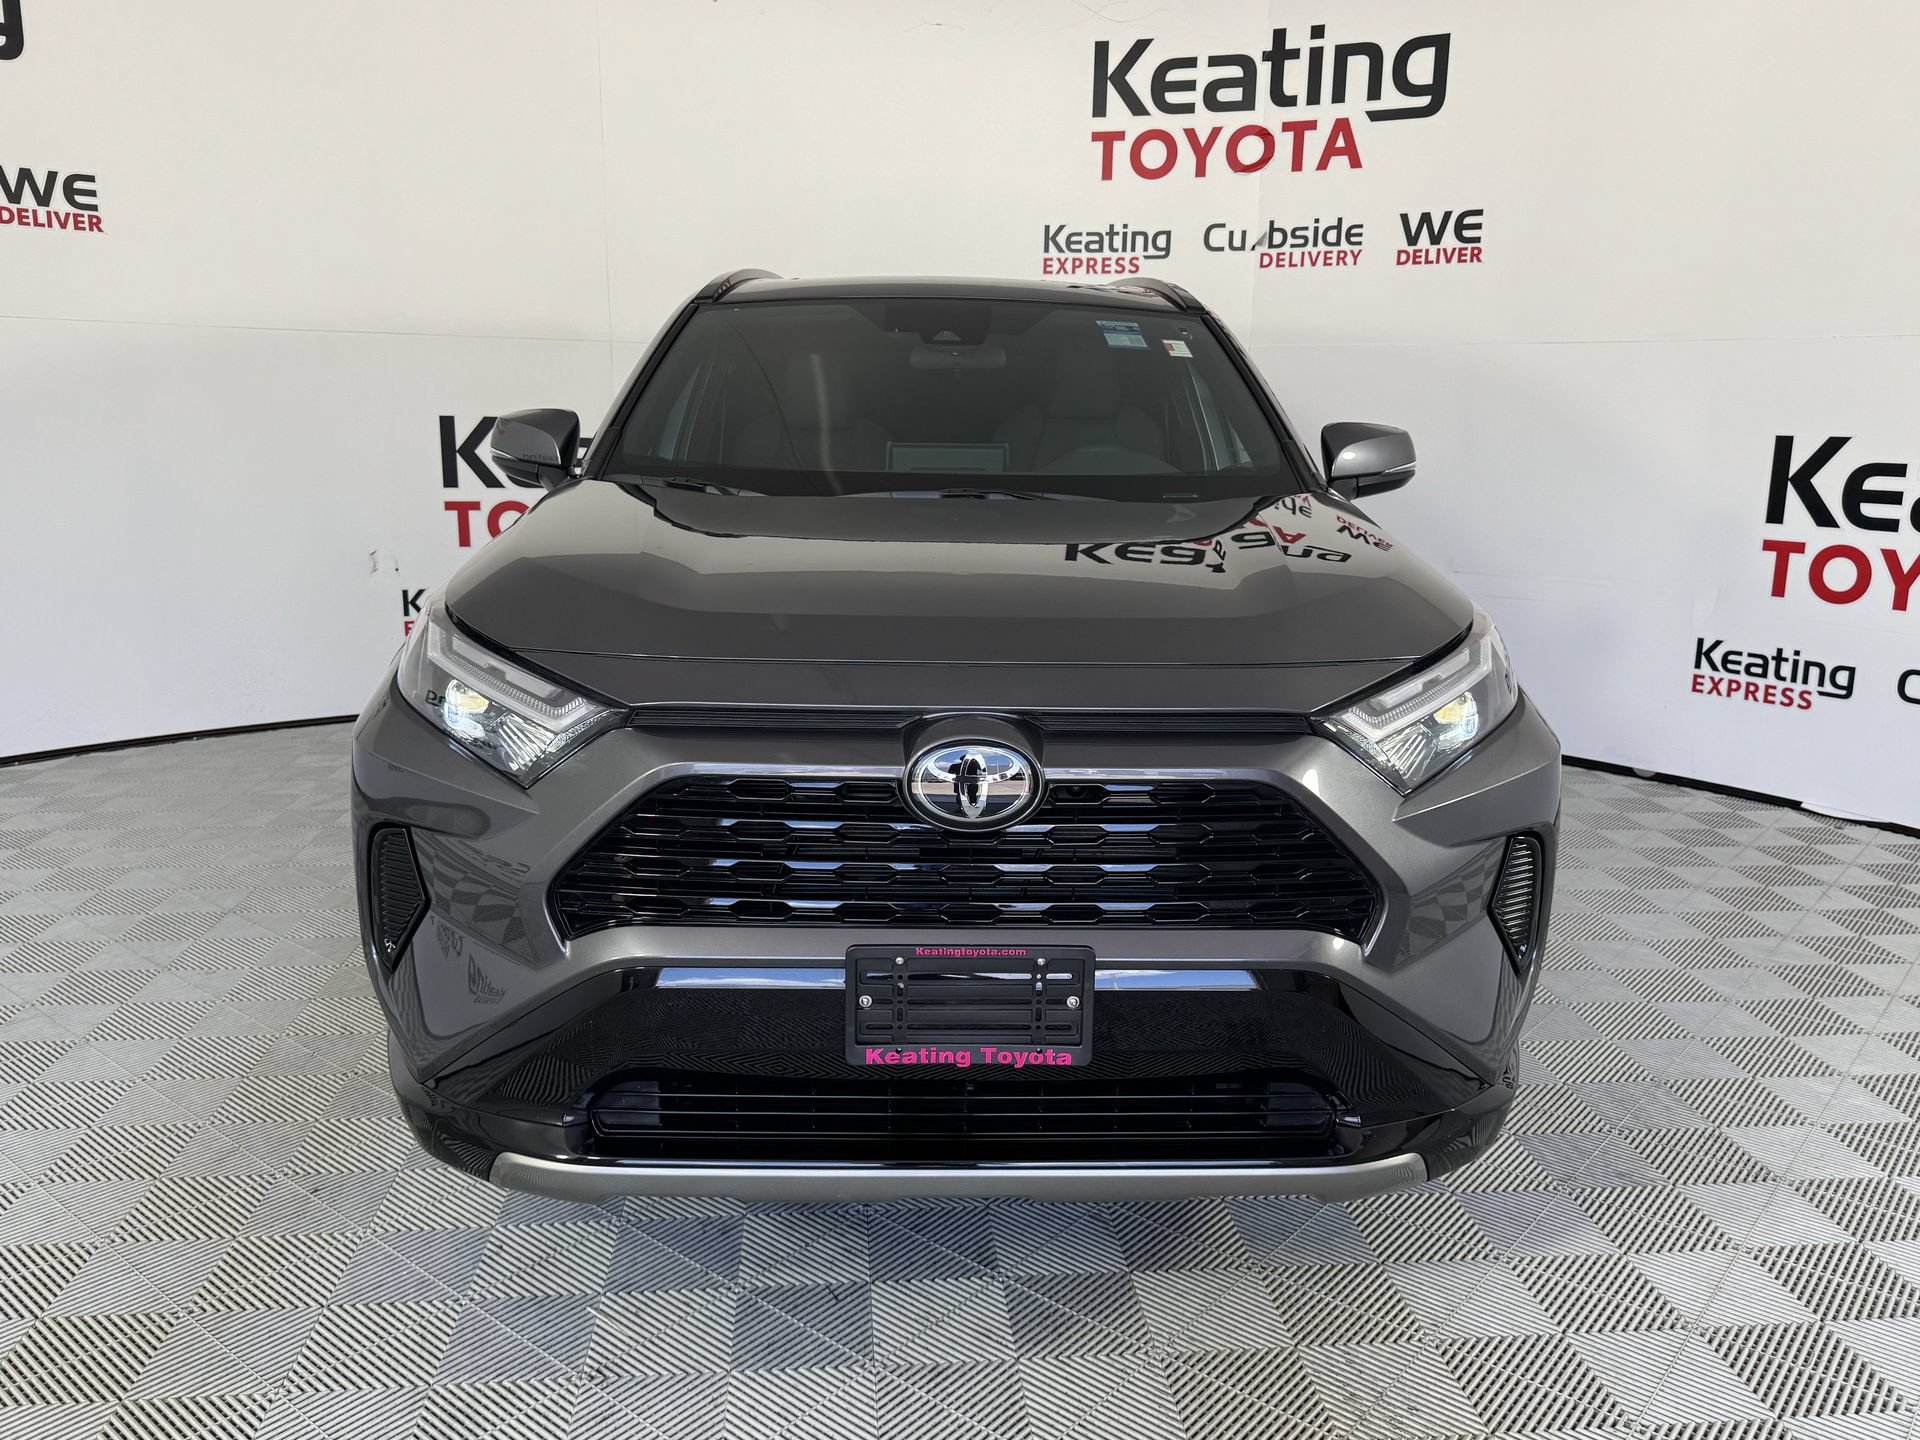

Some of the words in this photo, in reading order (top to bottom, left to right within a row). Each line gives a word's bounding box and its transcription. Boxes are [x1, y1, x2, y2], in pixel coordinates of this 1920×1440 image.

[1092, 23, 1451, 122] Keating
[1090, 117, 1363, 181] TOYOTA
[1043, 223, 1172, 260] Keating
[1203, 216, 1364, 252] Cubside
[1399, 208, 1484, 247] WE
[1042, 256, 1140, 275] EXPRESS
[1259, 249, 1363, 269] DELIVERY
[1395, 245, 1483, 266] DELIVER
[1765, 435, 1920, 533] Ke
[1693, 637, 1857, 700] Keating
[1690, 673, 1813, 710] EXPRESS
[915, 947, 1026, 958] Keatingtoyota.com
[865, 1047, 971, 1069] Keating
[980, 1047, 1072, 1069] Toyota
